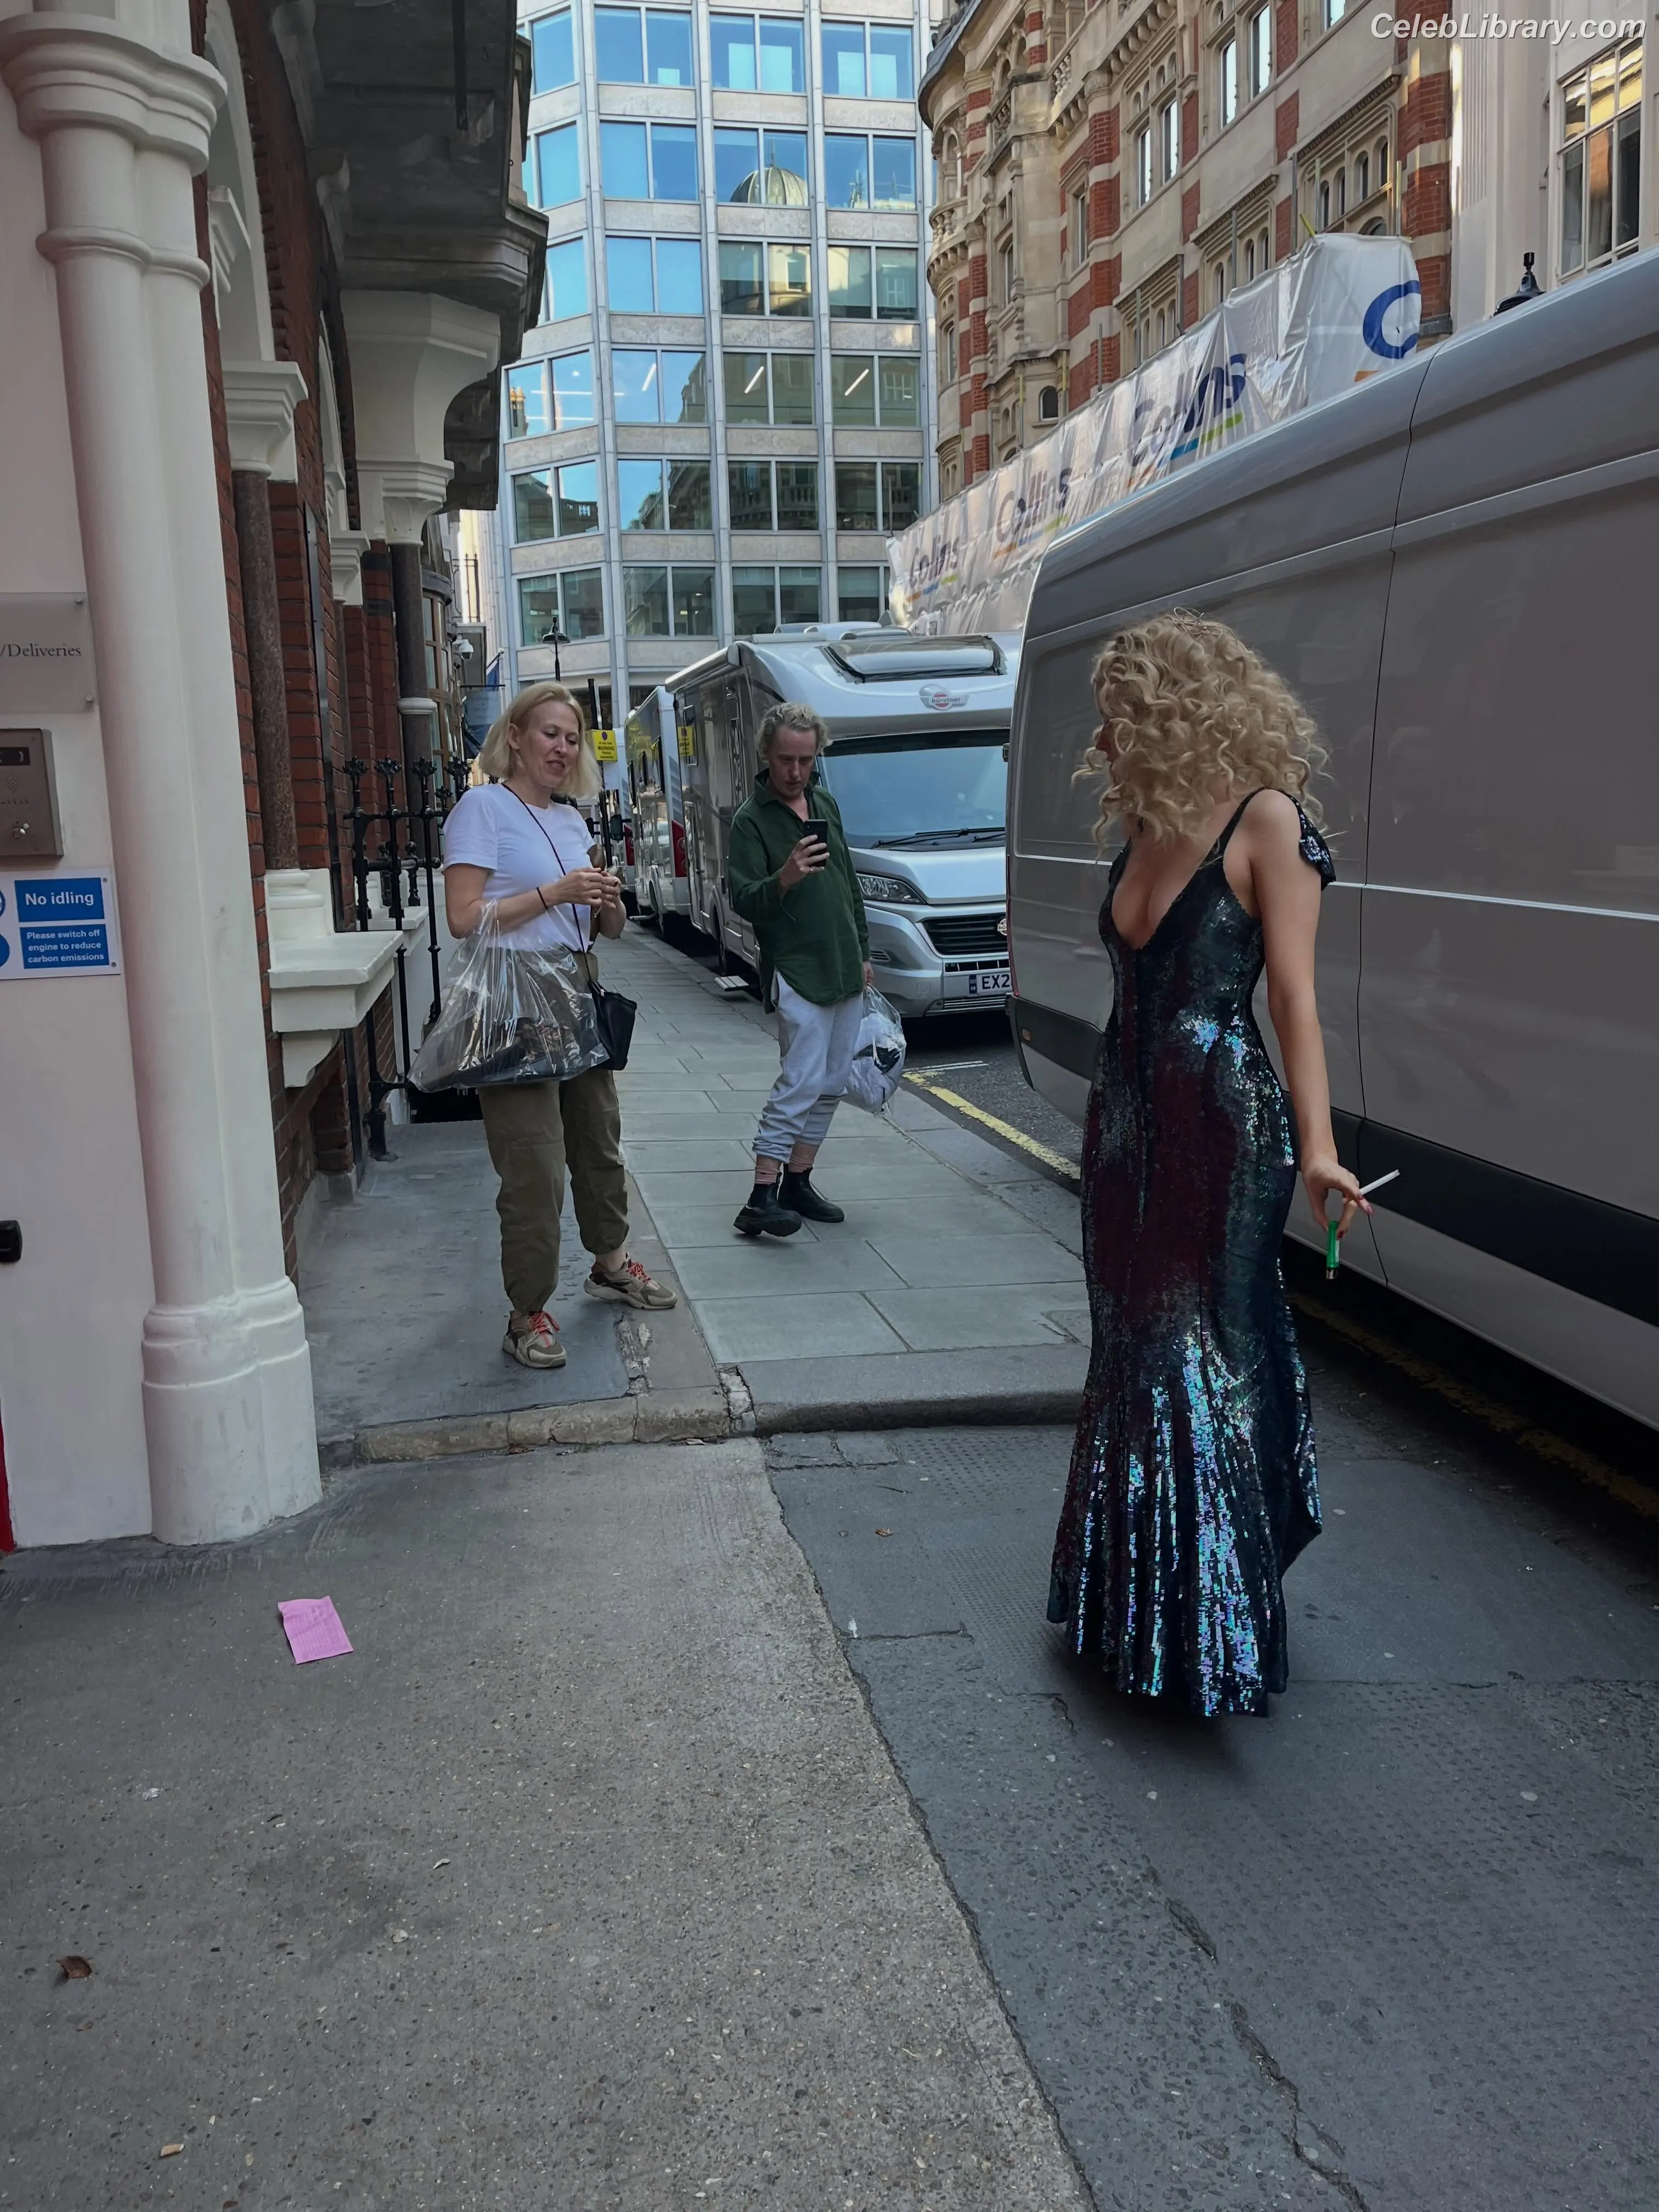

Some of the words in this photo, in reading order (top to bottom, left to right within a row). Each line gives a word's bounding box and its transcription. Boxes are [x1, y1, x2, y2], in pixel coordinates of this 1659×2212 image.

[25, 893, 47, 905] No
[50, 891, 94, 906] idling
[58, 930, 86, 938] switch
[88, 929, 100, 937] off
[28, 944, 58, 952] engine
[71, 941, 101, 950] reduce
[28, 955, 58, 963] carbon
